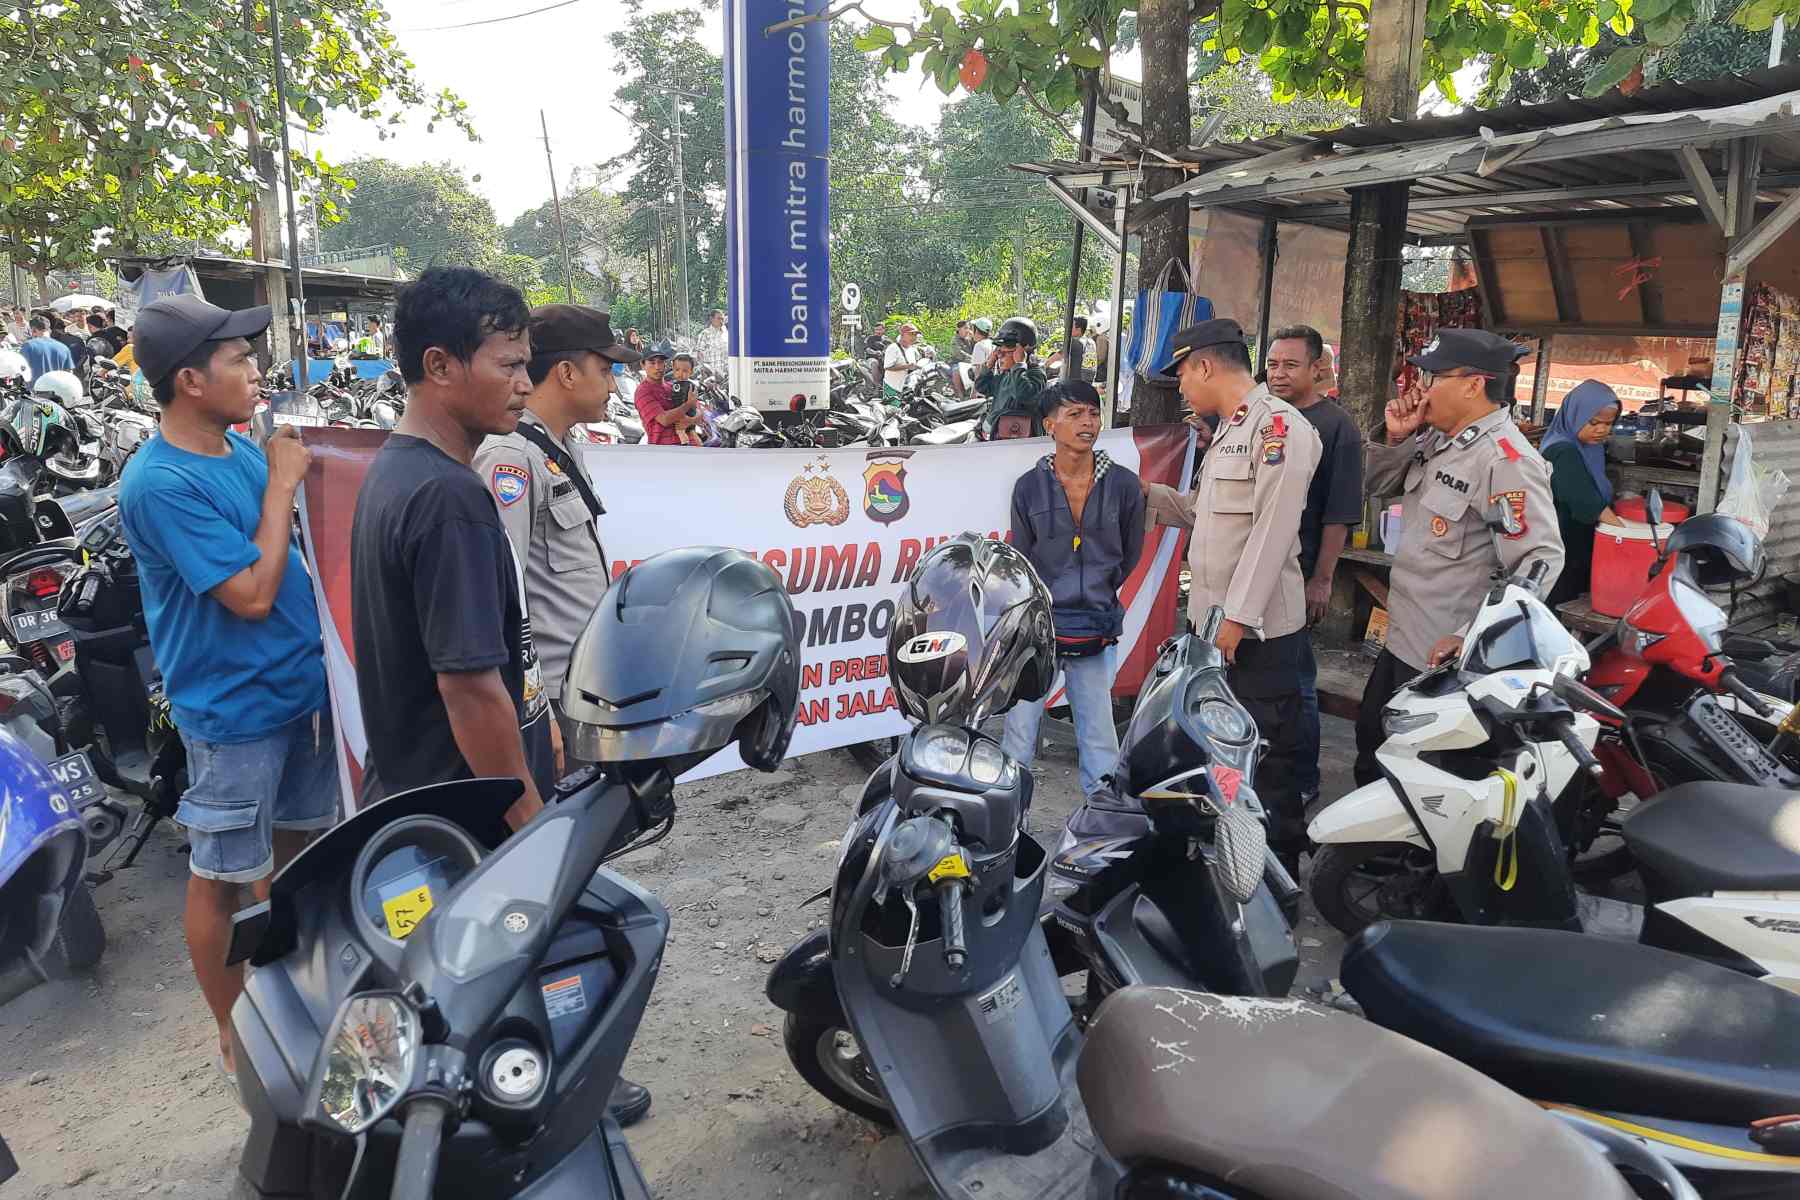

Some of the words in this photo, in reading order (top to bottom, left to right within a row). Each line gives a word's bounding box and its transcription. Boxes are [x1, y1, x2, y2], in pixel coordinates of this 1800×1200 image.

[784, 161, 807, 250] mitra
[784, 261, 807, 344] bank
[1219, 444, 1248, 455] POLRI
[1434, 470, 1470, 495] POLRI
[909, 638, 952, 654] GM
